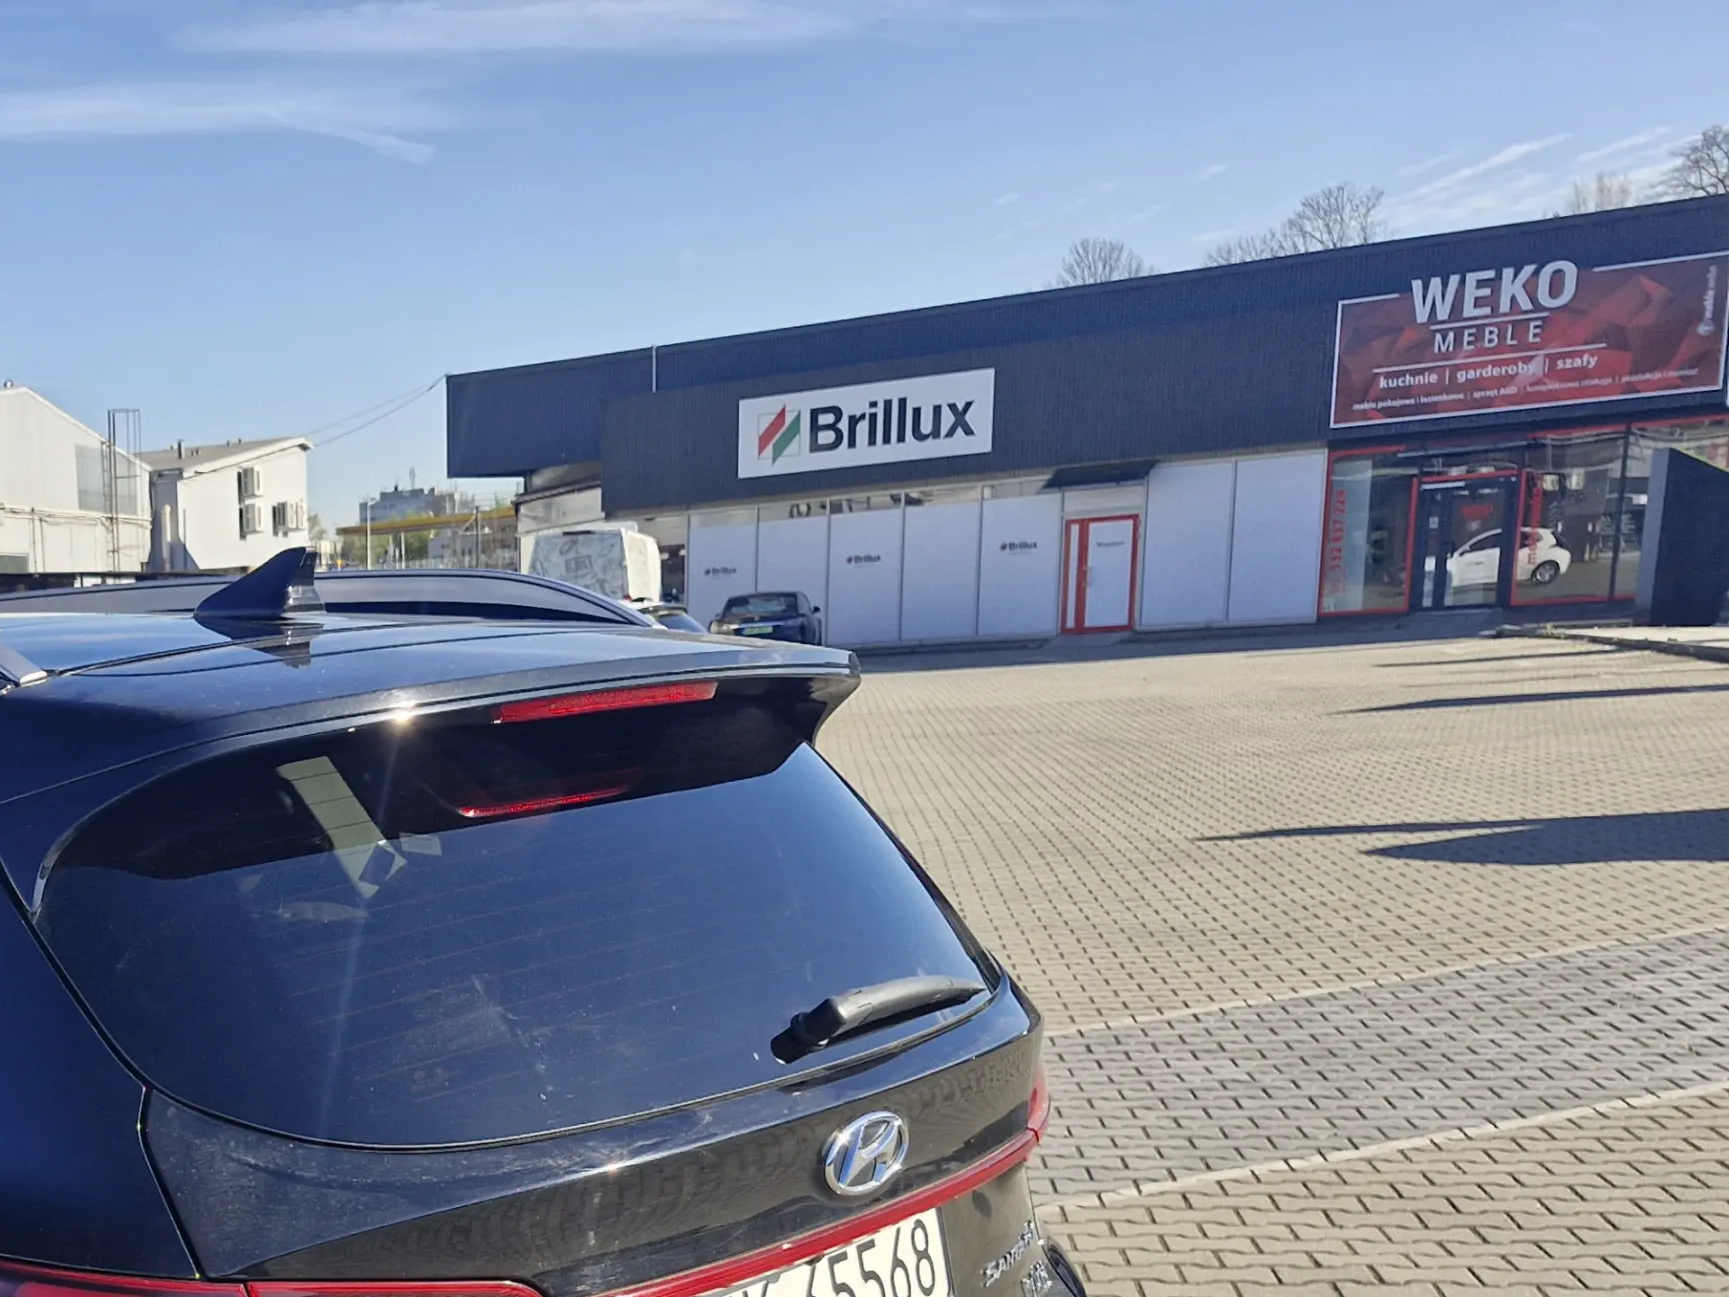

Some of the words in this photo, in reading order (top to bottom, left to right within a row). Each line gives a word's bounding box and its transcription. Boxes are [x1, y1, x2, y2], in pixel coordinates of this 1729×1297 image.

[1411, 260, 1578, 324] WEKO
[1434, 320, 1543, 354] MEBLE
[1379, 371, 1438, 389] kuchnie
[1456, 361, 1537, 383] garderoby
[1556, 353, 1598, 370] szafy
[808, 396, 976, 453] Brillux
